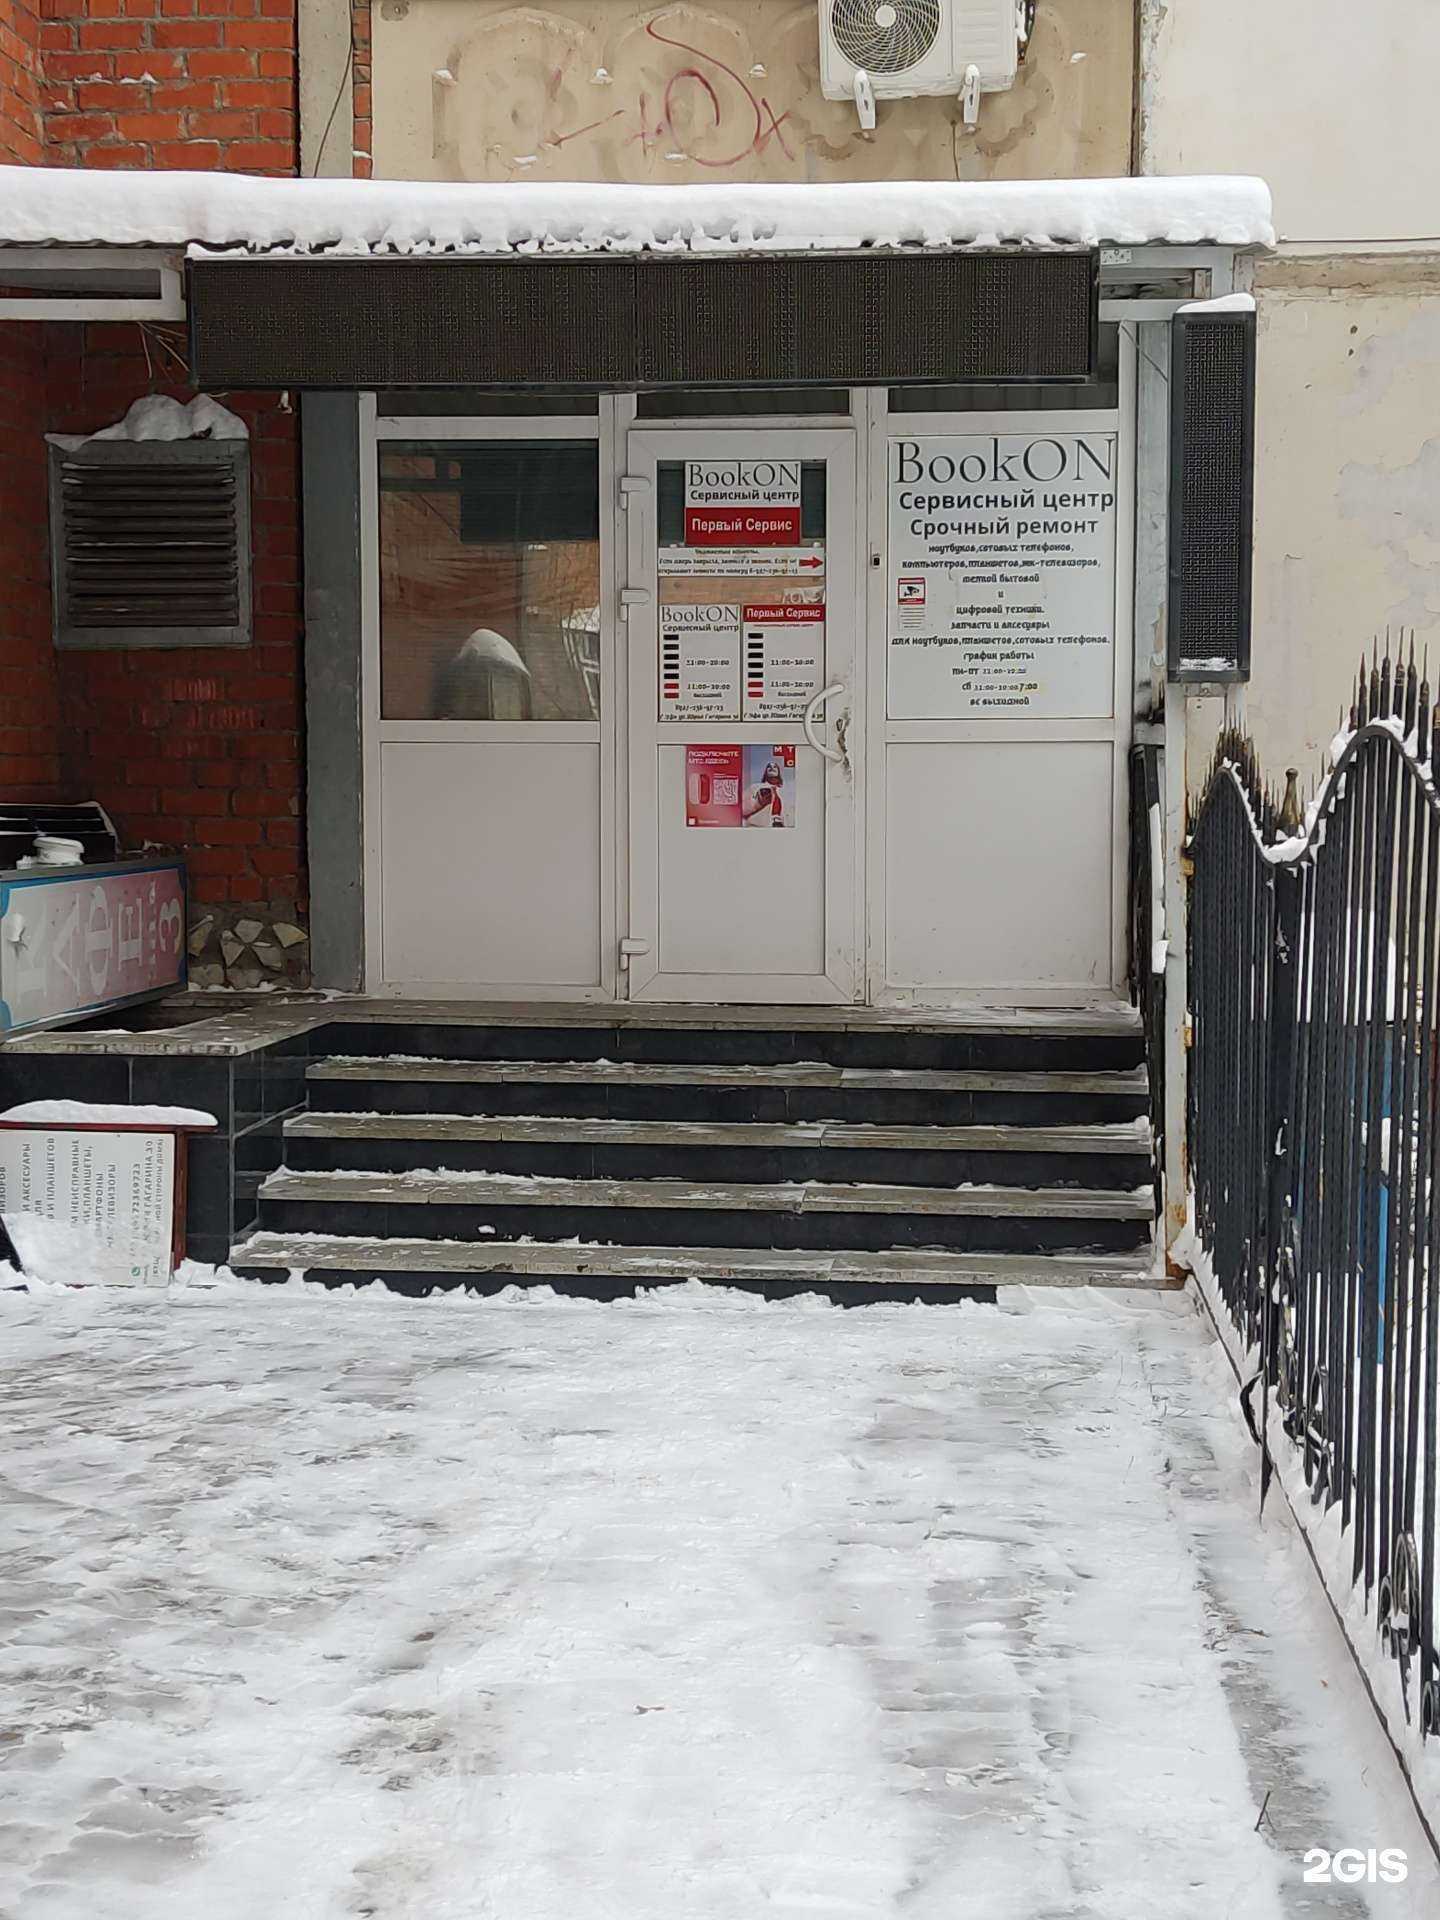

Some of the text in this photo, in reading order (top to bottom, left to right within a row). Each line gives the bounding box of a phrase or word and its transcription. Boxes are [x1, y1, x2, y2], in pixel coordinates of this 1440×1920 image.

[895, 437, 1115, 484] BookON
[688, 462, 799, 487] BookON
[690, 488, 800, 503] Сервисный центр
[899, 488, 1114, 514] Сервисный центр
[691, 517, 793, 533] Первый Сервис
[910, 516, 1098, 539] Срочный ремонт
[999, 573, 1040, 583] бытовой
[661, 605, 739, 623] BookON
[956, 604, 1003, 615] цифровой
[963, 651, 1035, 662] график работы
[982, 696, 1030, 706] выходной
[21, 1143, 31, 1200] АКСЕСУАРЫ
[46, 1137, 56, 1201] ПЛАНШЕТОВ
[70, 1139, 80, 1213] НЕИСПРАВНЫЕ
